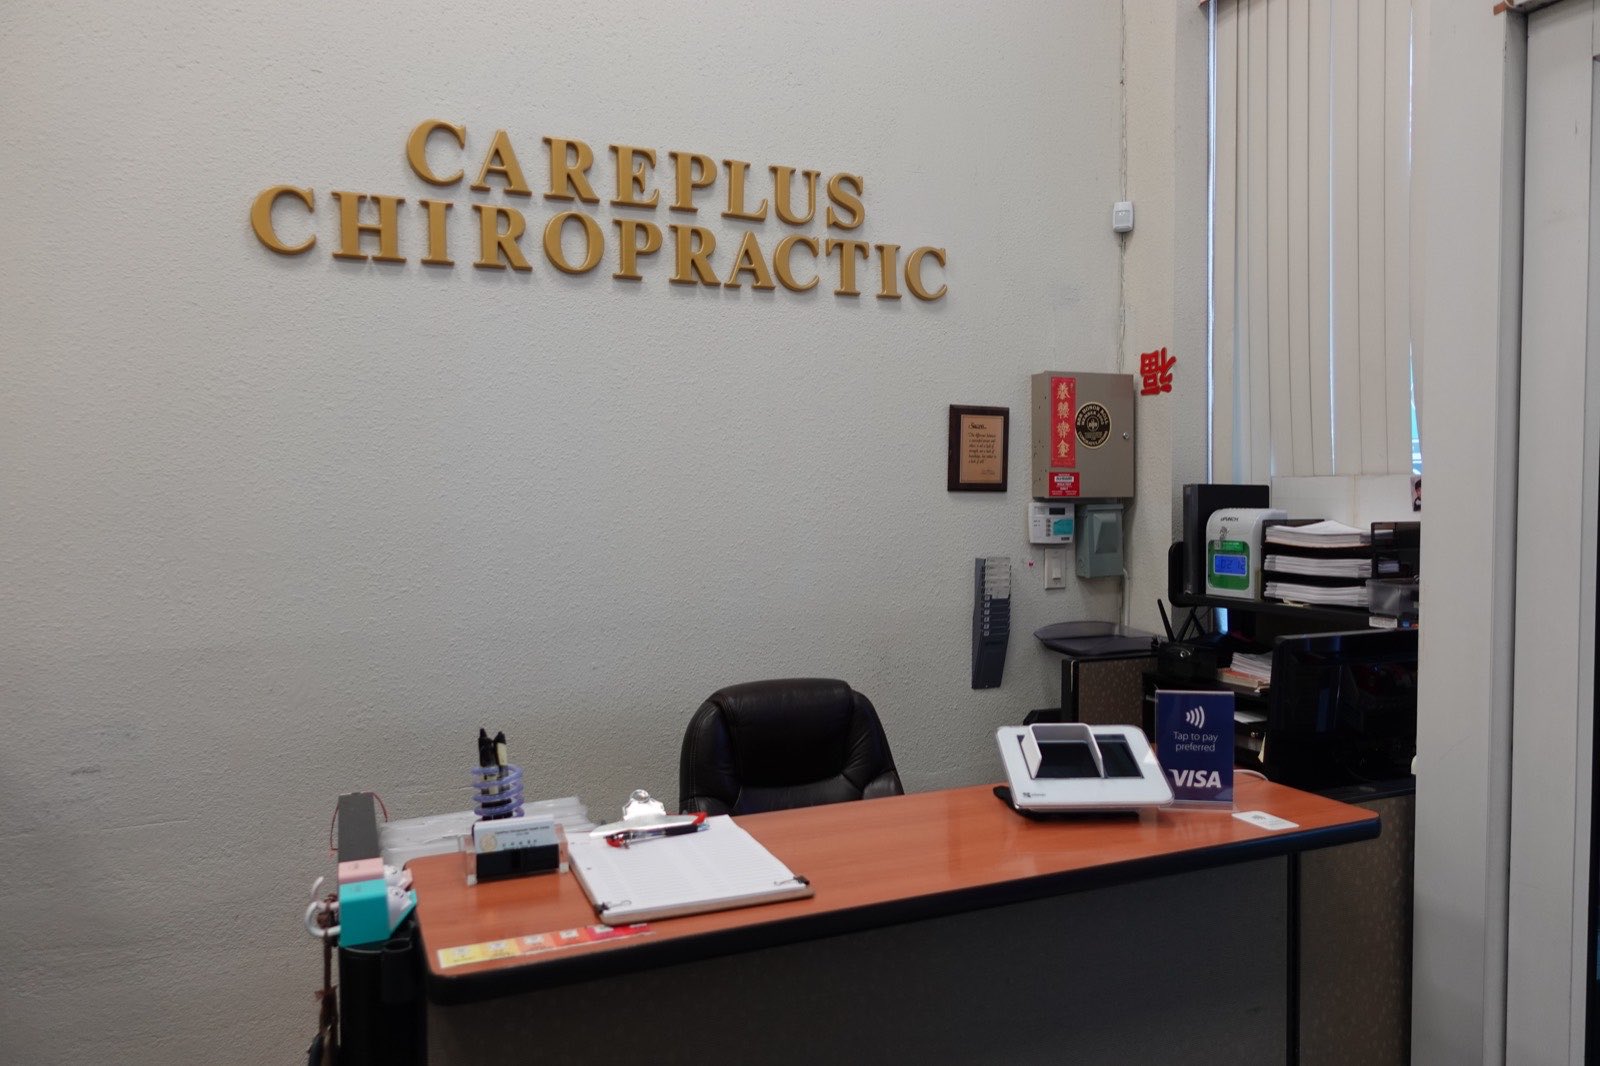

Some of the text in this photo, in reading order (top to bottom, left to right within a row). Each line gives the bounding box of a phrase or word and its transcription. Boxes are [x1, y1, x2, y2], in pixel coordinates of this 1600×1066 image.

[407, 119, 865, 230] CAREPLUS
[251, 185, 949, 301] CHIROPRACTIC
[1173, 731, 1218, 743] Tap to pay
[1175, 742, 1216, 752] preferred
[1168, 768, 1222, 788] VISA
